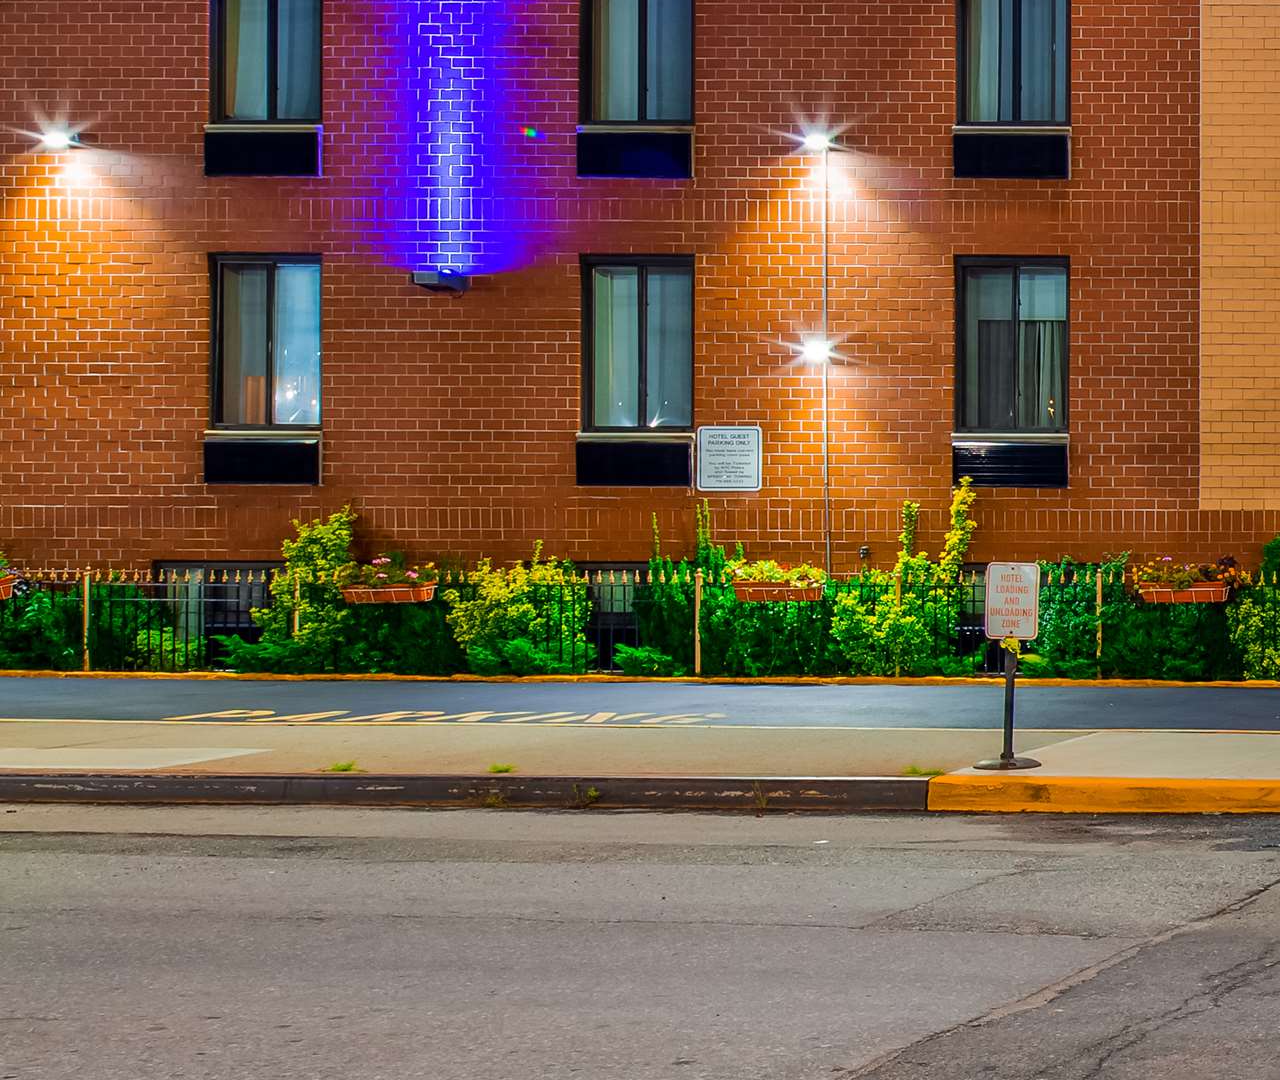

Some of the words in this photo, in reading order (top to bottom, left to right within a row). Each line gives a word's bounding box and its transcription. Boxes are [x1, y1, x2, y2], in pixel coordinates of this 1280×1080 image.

[1000, 574, 1025, 582] HOTEL
[996, 585, 1029, 594] LOADING
[1004, 597, 1020, 605] AND
[990, 607, 1033, 617] UNLOADING
[1001, 619, 1021, 628] ZONE
